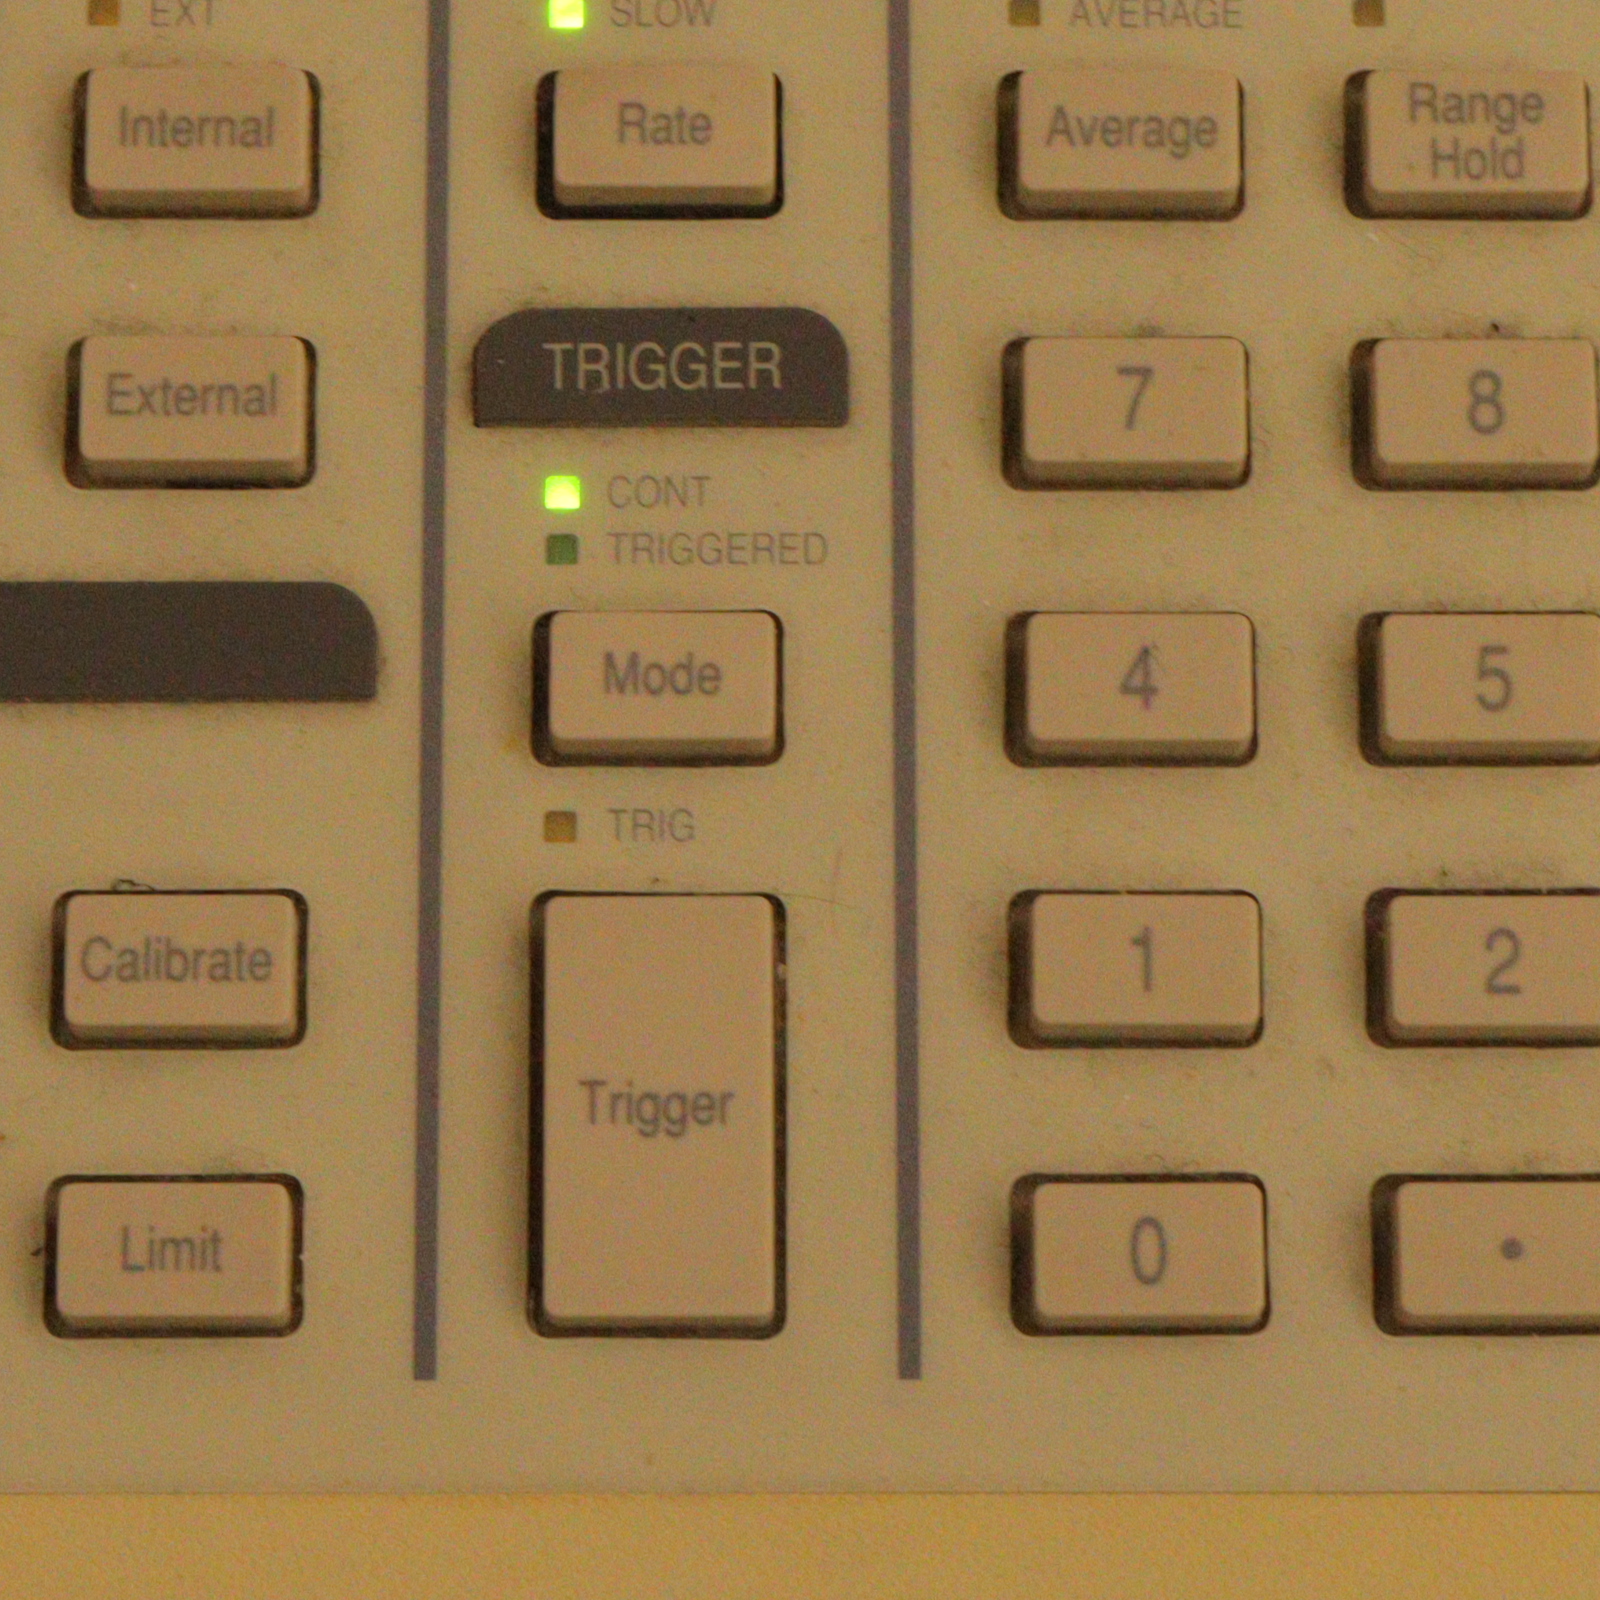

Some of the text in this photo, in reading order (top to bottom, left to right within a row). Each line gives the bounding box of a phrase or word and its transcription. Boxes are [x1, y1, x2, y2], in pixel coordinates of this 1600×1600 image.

[118, 105, 276, 150] Internal
[616, 101, 714, 147] Rate
[1045, 104, 1218, 162] Average
[1407, 80, 1547, 134] Range
[1428, 138, 1526, 179] Hold
[542, 340, 782, 393] TRIGGER
[105, 371, 278, 419] External
[1115, 364, 1155, 431] 7
[1466, 368, 1506, 437] 8
[606, 473, 712, 511] CONT
[606, 530, 830, 567] TRIGGERED
[602, 650, 724, 698] Mode
[1118, 644, 1160, 710] 4
[1475, 643, 1514, 714] 5
[607, 807, 696, 845] TRIG
[81, 934, 274, 984] Calibrate
[1129, 925, 1154, 994] 1
[1483, 926, 1523, 997] 2
[577, 1077, 736, 1141] Trigger
[119, 1224, 224, 1275] Limit
[1128, 1214, 1169, 1287] 0
